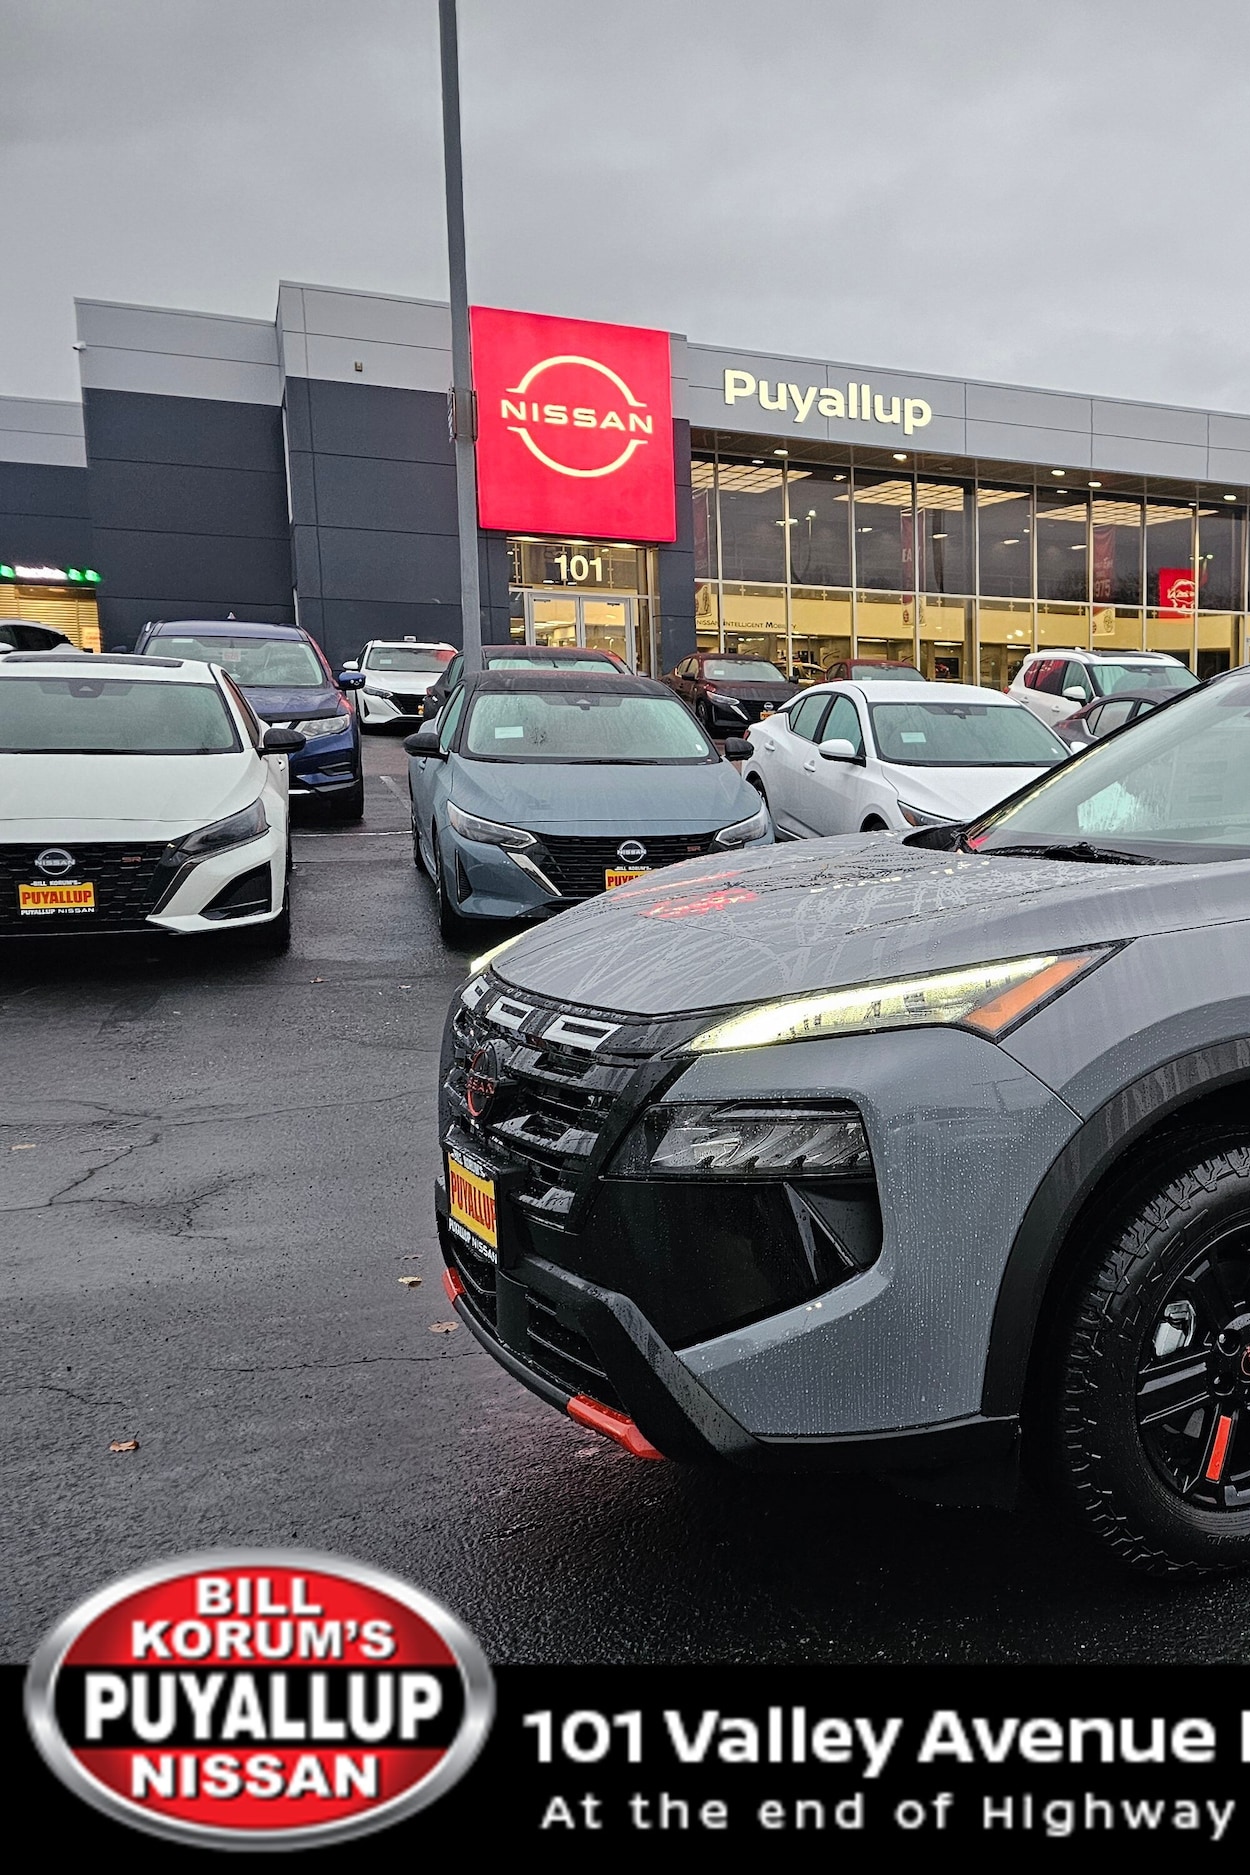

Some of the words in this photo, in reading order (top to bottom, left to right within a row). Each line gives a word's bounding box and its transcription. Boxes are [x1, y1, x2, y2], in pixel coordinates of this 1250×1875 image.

[501, 399, 653, 435] NISSAN
[724, 368, 932, 435] Puyallup
[554, 555, 602, 581] 101
[22, 890, 92, 905] PUYALLUP
[450, 1170, 496, 1233] PUYALLUP
